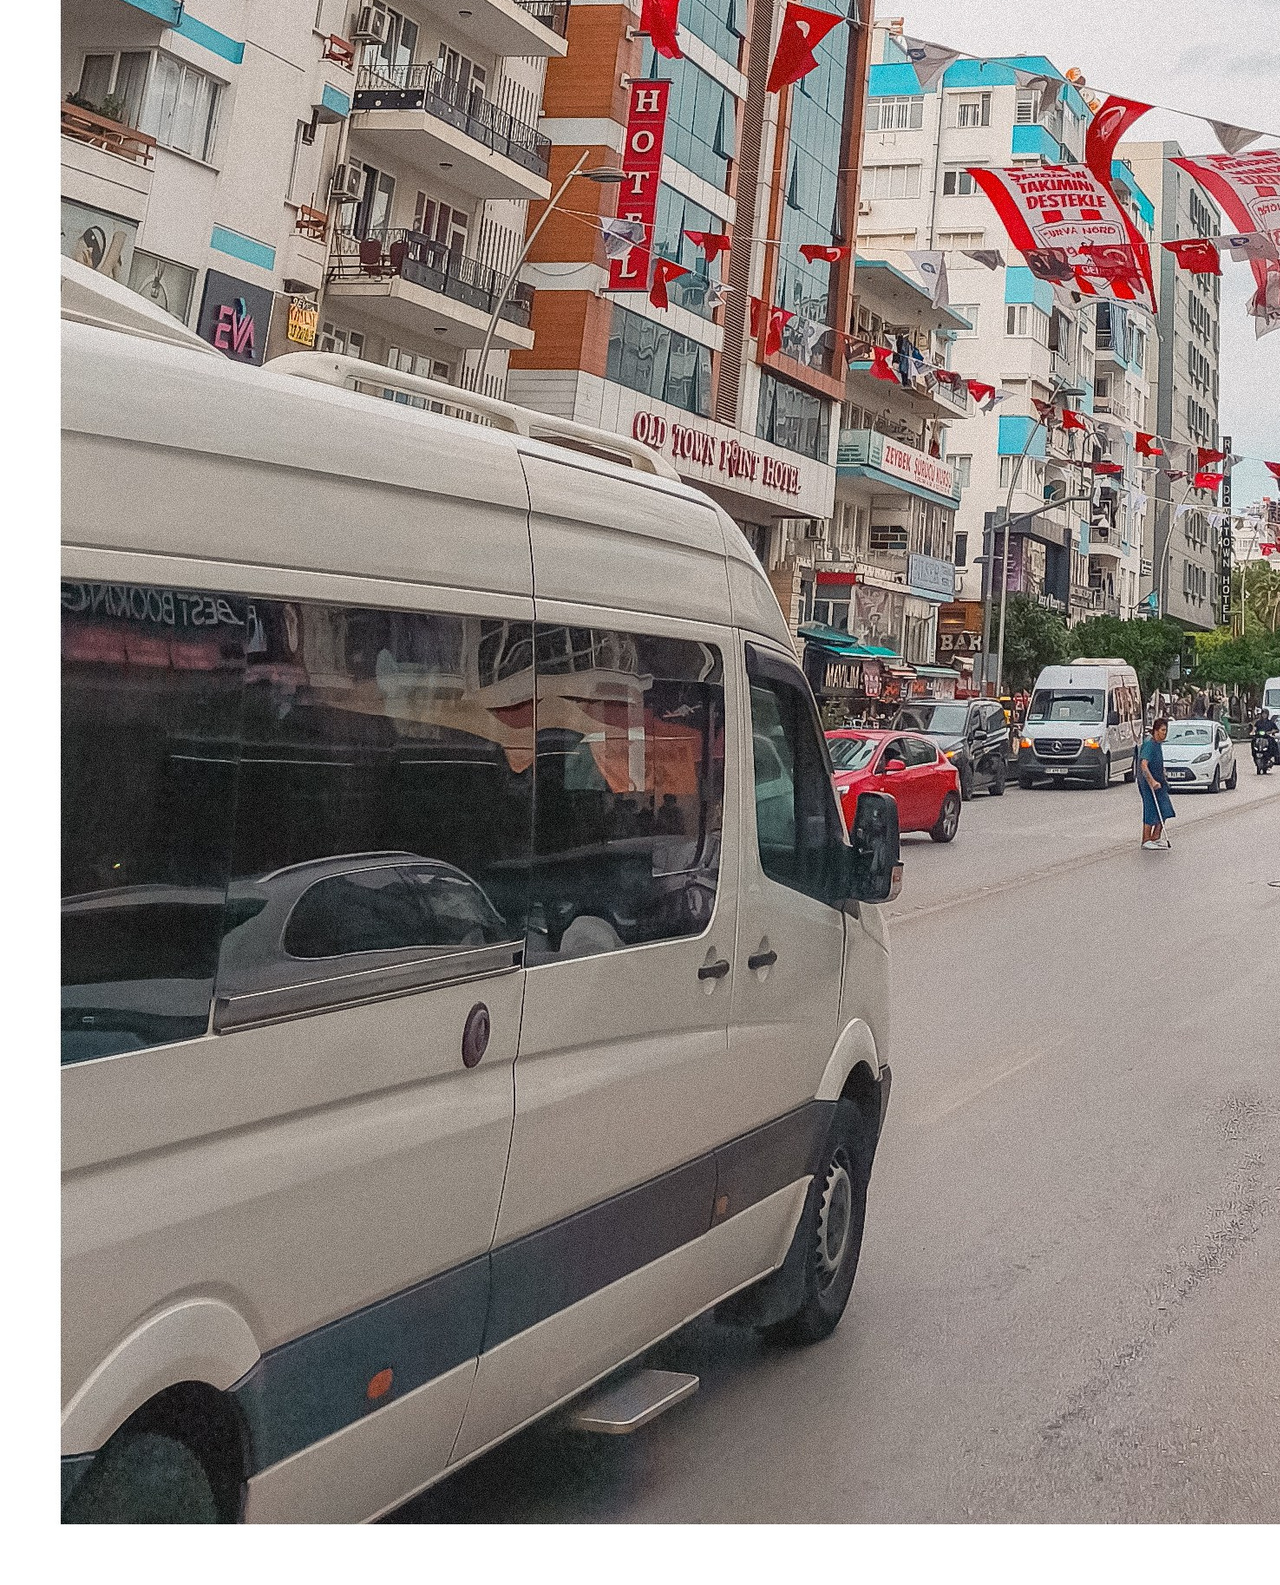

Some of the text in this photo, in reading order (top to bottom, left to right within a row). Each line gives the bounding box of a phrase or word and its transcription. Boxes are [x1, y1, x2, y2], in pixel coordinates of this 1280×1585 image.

[1017, 179, 1095, 194] TAKIMINI
[1026, 193, 1107, 210] DESTEKLE
[1082, 225, 1116, 235] NORD
[632, 410, 667, 450] OLD
[671, 423, 717, 467] TOWN
[762, 456, 802, 496] HOTEL
[885, 445, 912, 472] ZEYBEK
[1222, 575, 1230, 623] HOTEL
